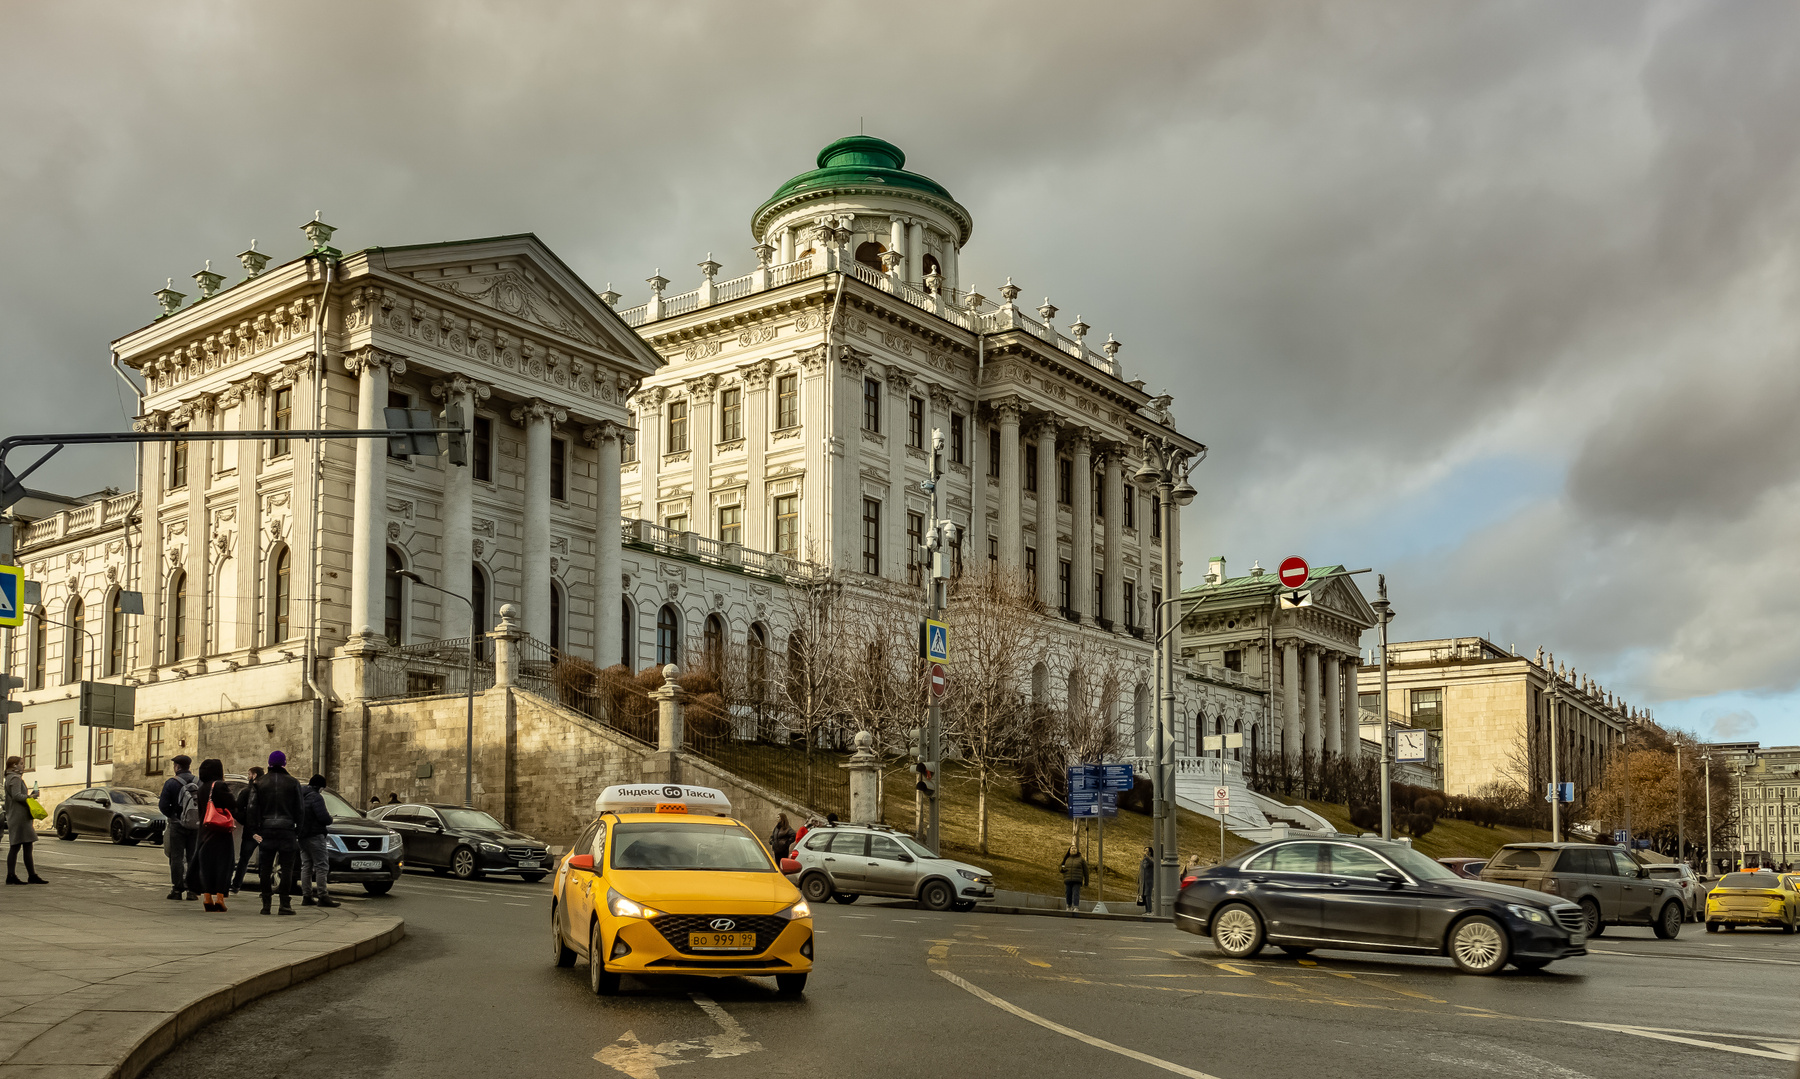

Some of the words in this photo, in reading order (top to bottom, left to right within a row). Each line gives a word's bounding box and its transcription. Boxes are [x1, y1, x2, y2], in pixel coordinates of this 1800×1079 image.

[618, 788, 660, 796] Яндекс
[664, 787, 681, 796] Go
[683, 788, 716, 799] Такси
[713, 934, 734, 945] 999
[741, 934, 752, 942] 99
